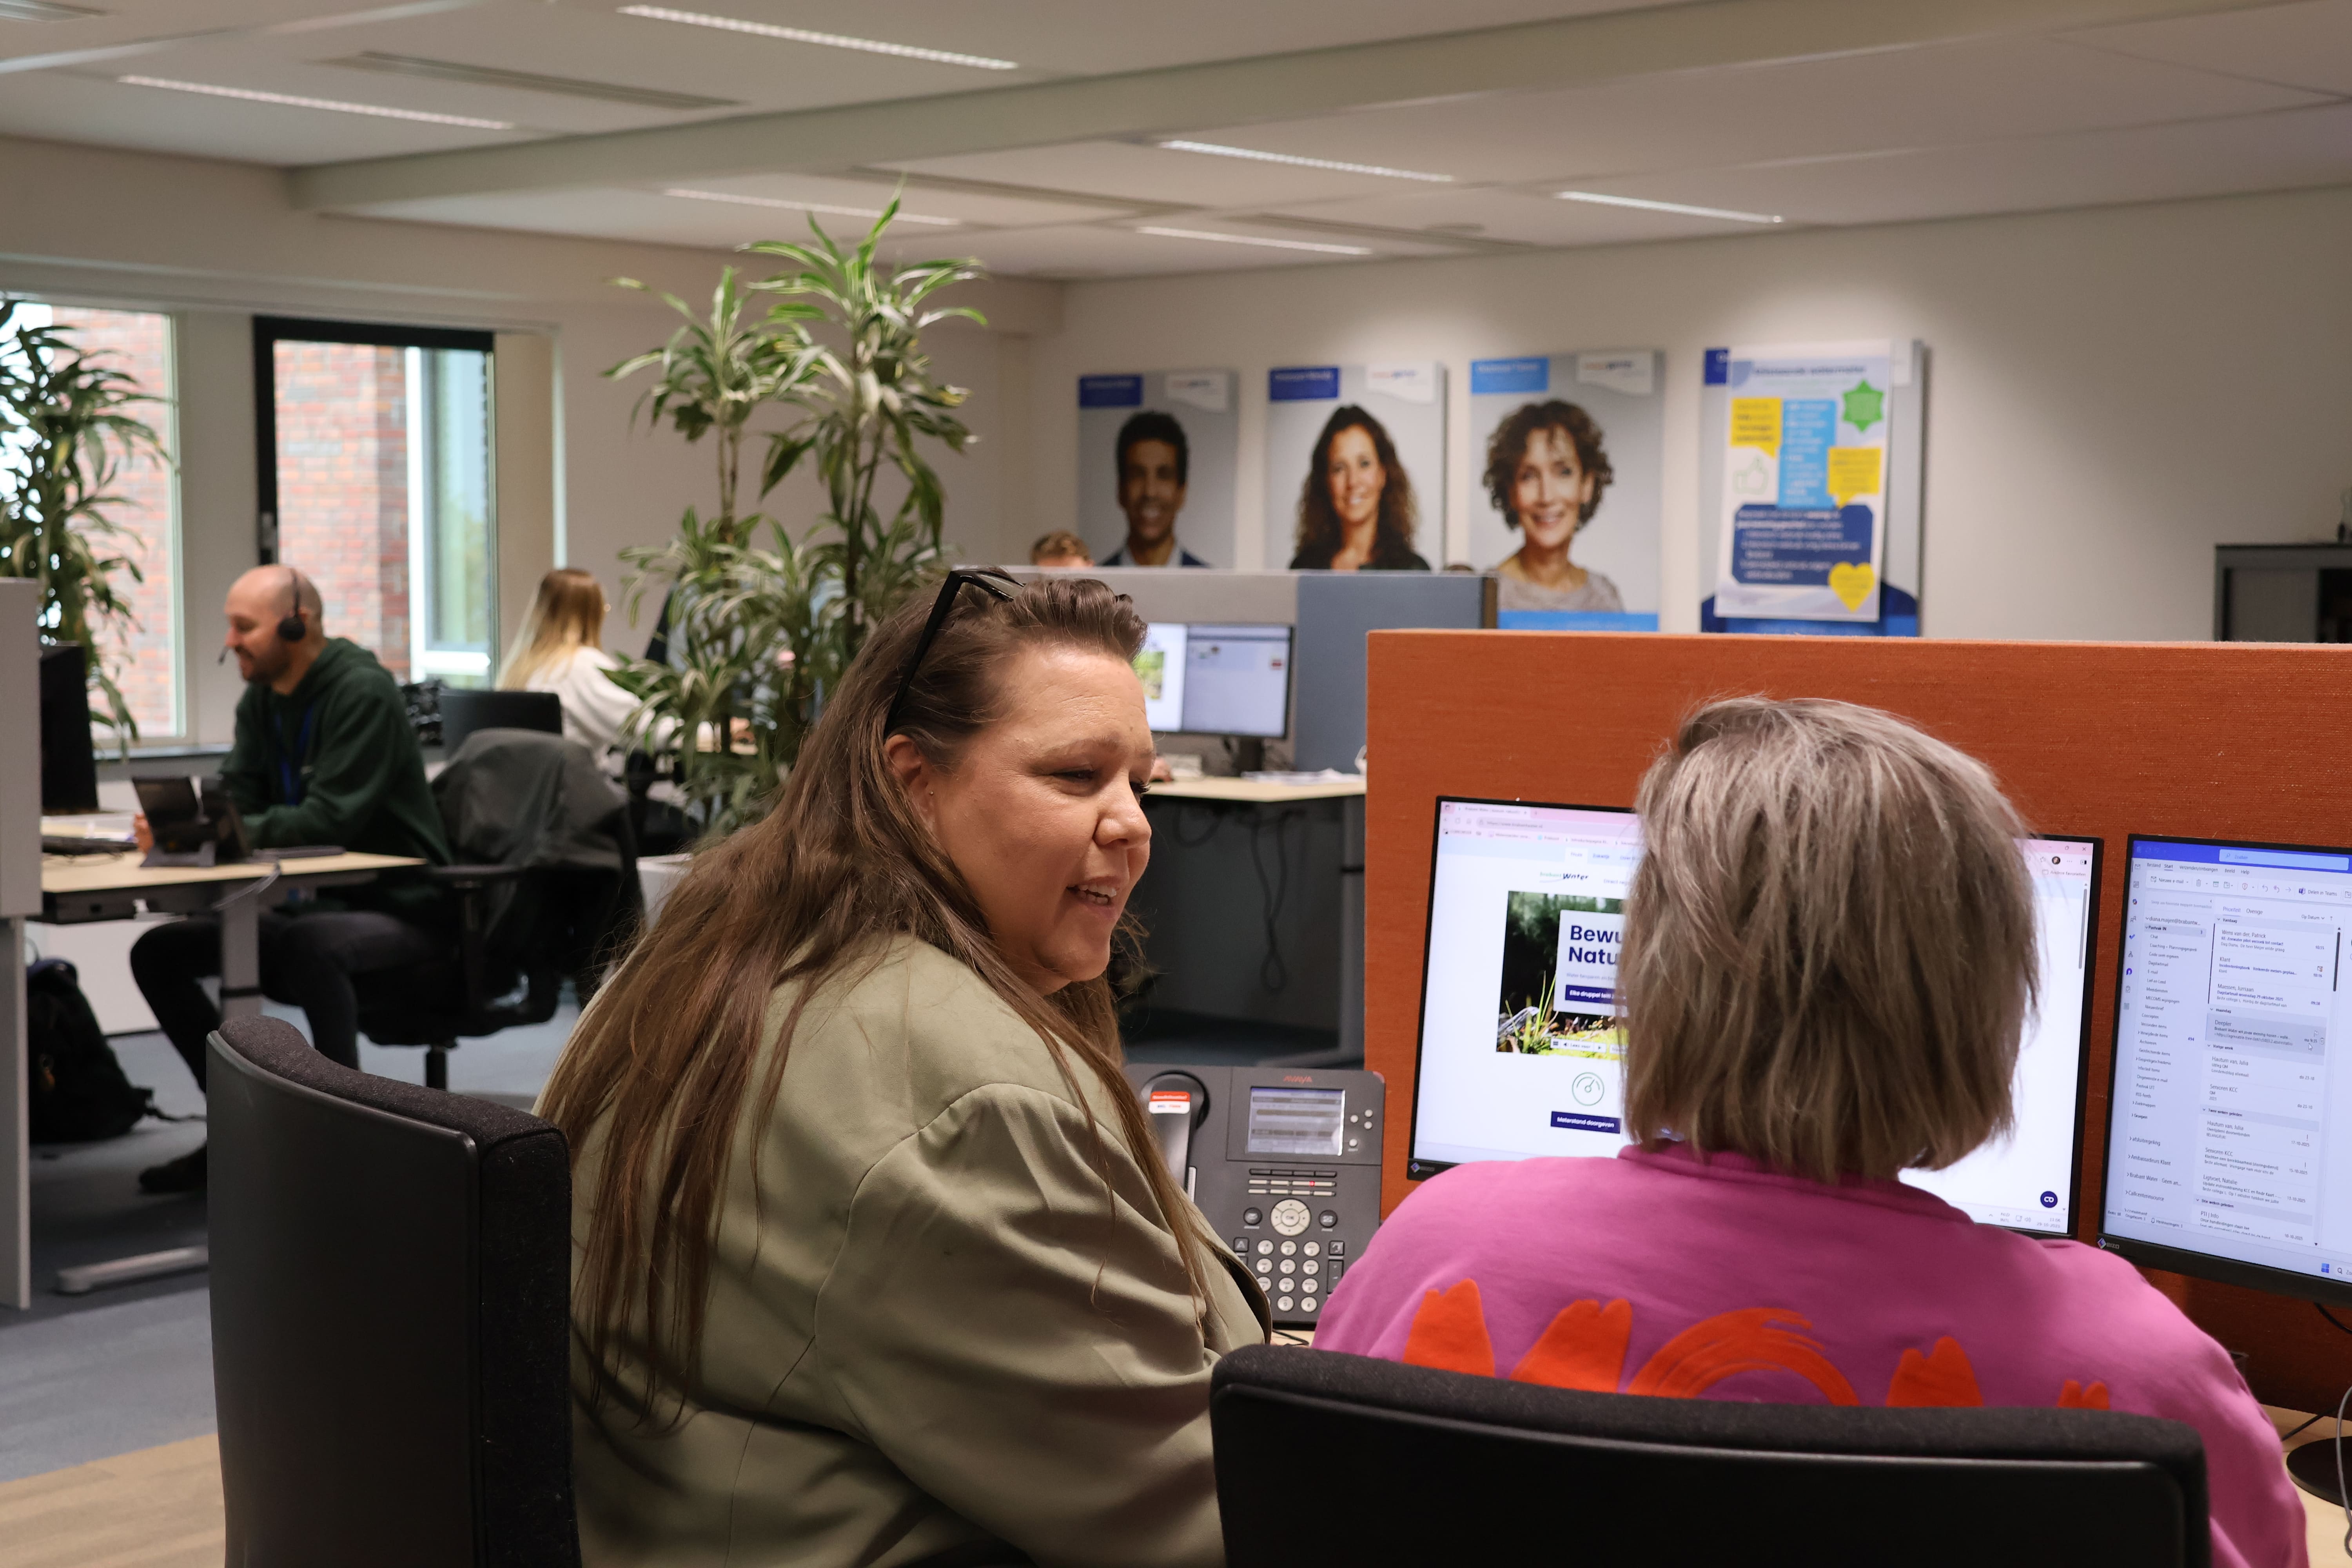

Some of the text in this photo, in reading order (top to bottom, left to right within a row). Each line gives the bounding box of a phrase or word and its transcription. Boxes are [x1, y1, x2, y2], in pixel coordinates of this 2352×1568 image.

[1568, 946, 1617, 965] Natu
[1283, 1075, 1312, 1083] AVAYA
[1557, 1116, 1615, 1128] Meterstand doorgeven
[2132, 1137, 2161, 1146] afsluitregeling
[2222, 1177, 2238, 1185] Natalie
